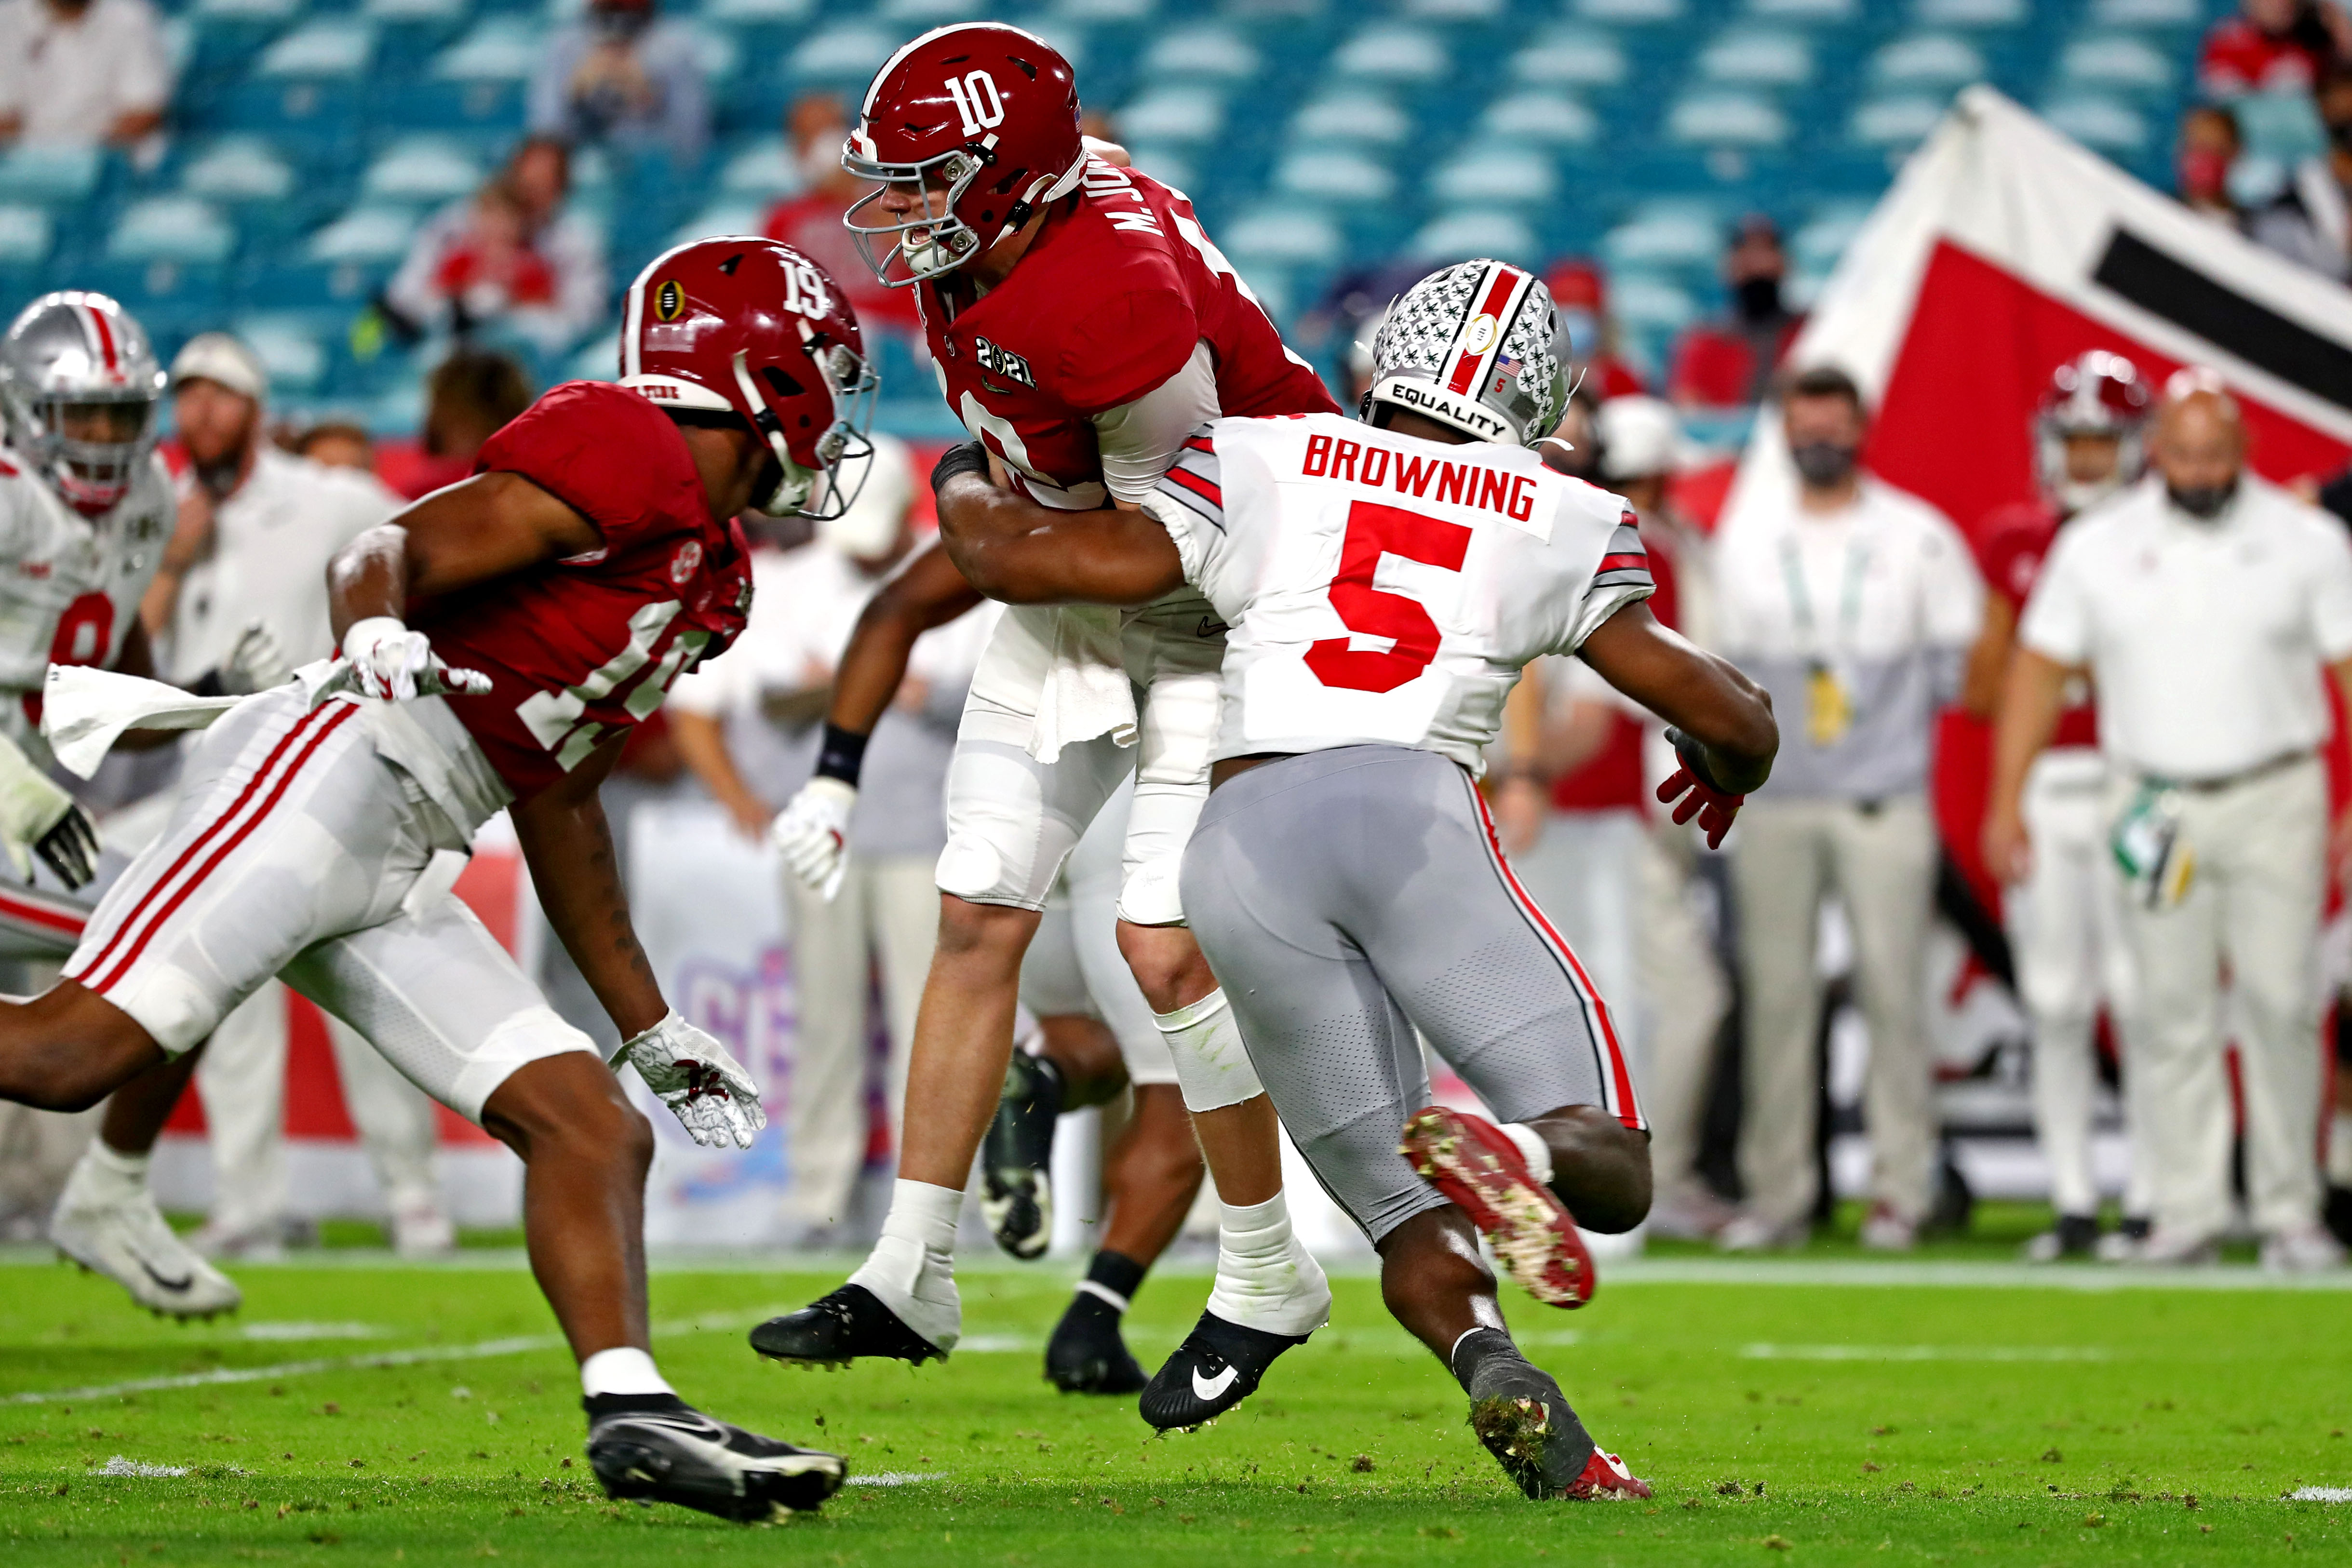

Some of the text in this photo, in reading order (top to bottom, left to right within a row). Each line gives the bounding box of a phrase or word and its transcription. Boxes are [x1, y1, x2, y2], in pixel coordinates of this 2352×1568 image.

[944, 70, 1005, 137] 10
[1082, 150, 1165, 237] M. JON
[778, 260, 827, 321] 19
[975, 335, 1038, 389] 2021
[1494, 378, 1506, 393] 5
[1392, 384, 1505, 436] EQUALITY
[1302, 434, 1537, 522] BROWNING
[1303, 499, 1474, 694] 5
